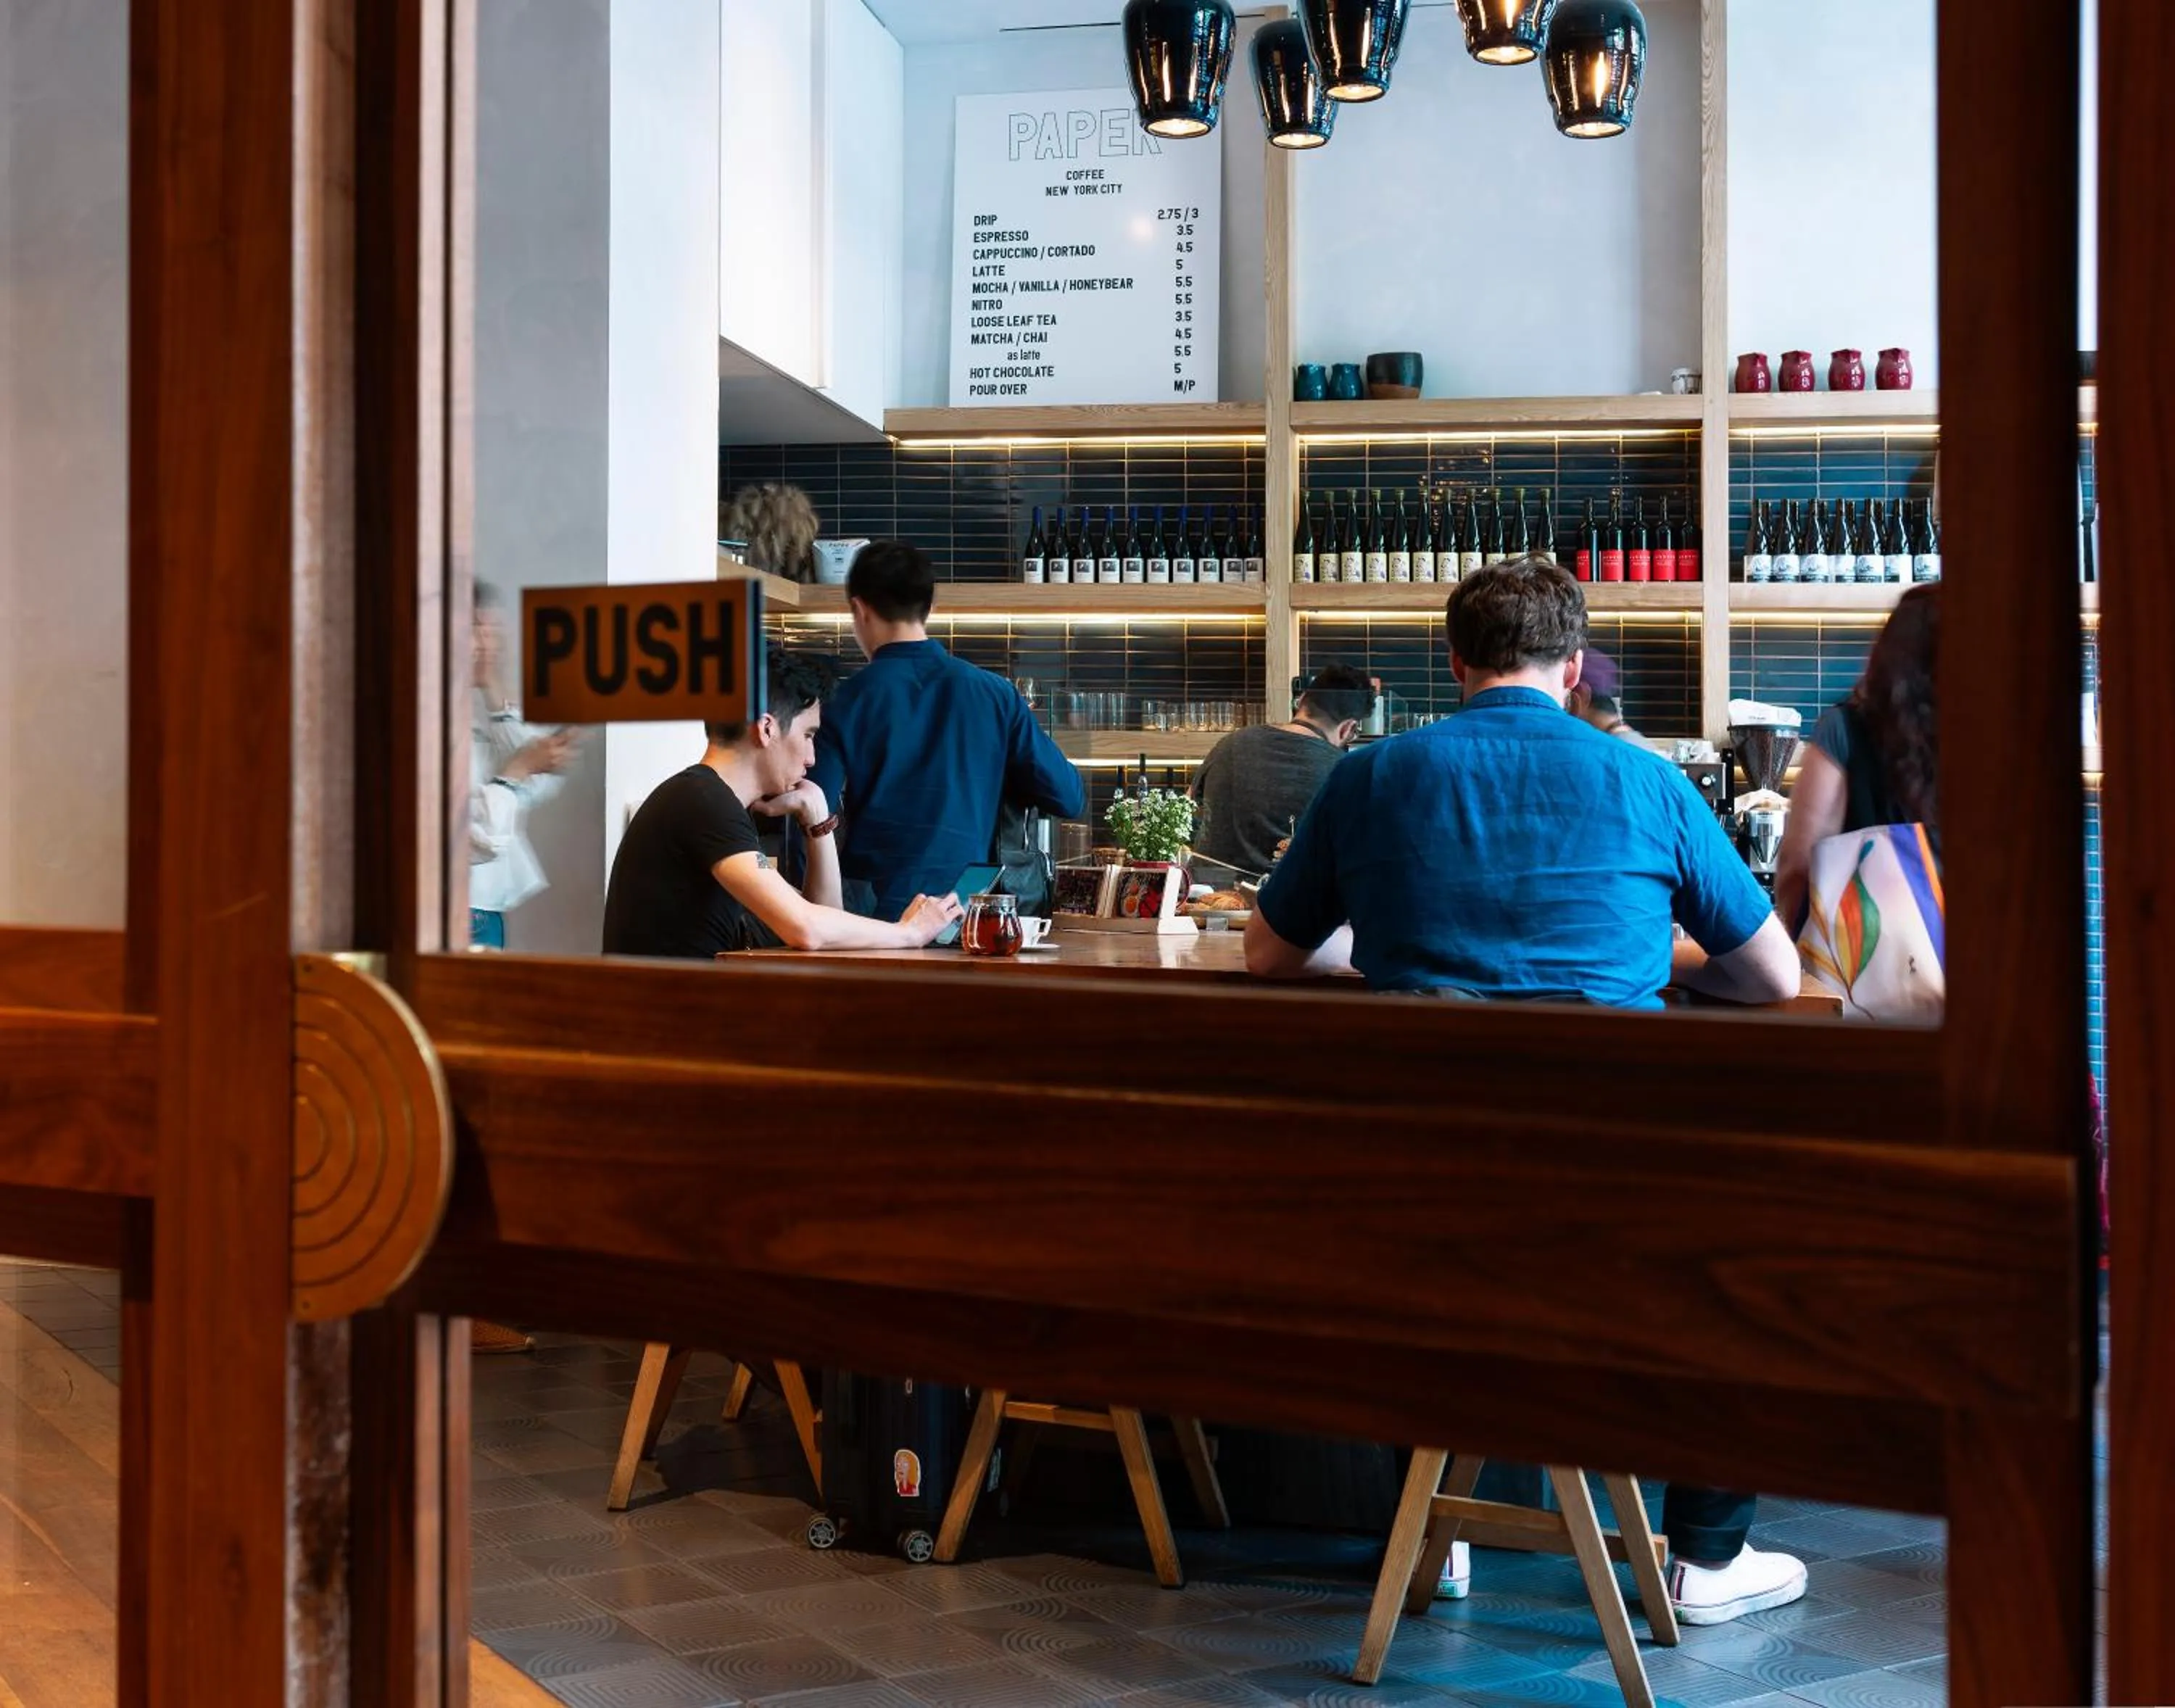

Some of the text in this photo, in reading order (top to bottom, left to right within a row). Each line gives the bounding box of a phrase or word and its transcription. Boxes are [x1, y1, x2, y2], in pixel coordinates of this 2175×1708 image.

[1065, 169, 1105, 181] COFFEE
[1045, 183, 1123, 196] NEW YORK CITY
[974, 214, 998, 227] DRIP
[1157, 207, 1199, 222] 2.75 / 3
[1177, 224, 1194, 236] 3.5
[973, 230, 1030, 244] ESPRESSO
[972, 244, 1095, 260] CAPPUCCINO / CORTADO
[1176, 241, 1193, 253] 4.5
[1175, 258, 1184, 270] 5
[972, 265, 1006, 278] LATTE
[972, 278, 1134, 296] MOCHA / VANILLA / HONEYBEAR
[1175, 275, 1193, 288] 5.5
[971, 299, 1003, 311] NITRO
[1174, 292, 1193, 305] 5.5
[971, 314, 1057, 328] LOOSE LEAF TEA
[1174, 310, 1193, 323] 3.5
[970, 331, 1048, 347] MATCHA / CHAI
[1174, 327, 1193, 340] 4.5
[1007, 348, 1041, 361] as latte
[1174, 344, 1192, 357] 5.5
[969, 365, 1055, 379] HOT CHOCOLATE
[1174, 362, 1182, 374] 5
[969, 383, 1027, 397] POUR OVER
[1174, 379, 1196, 395] M/P
[534, 600, 734, 697] PUSH
